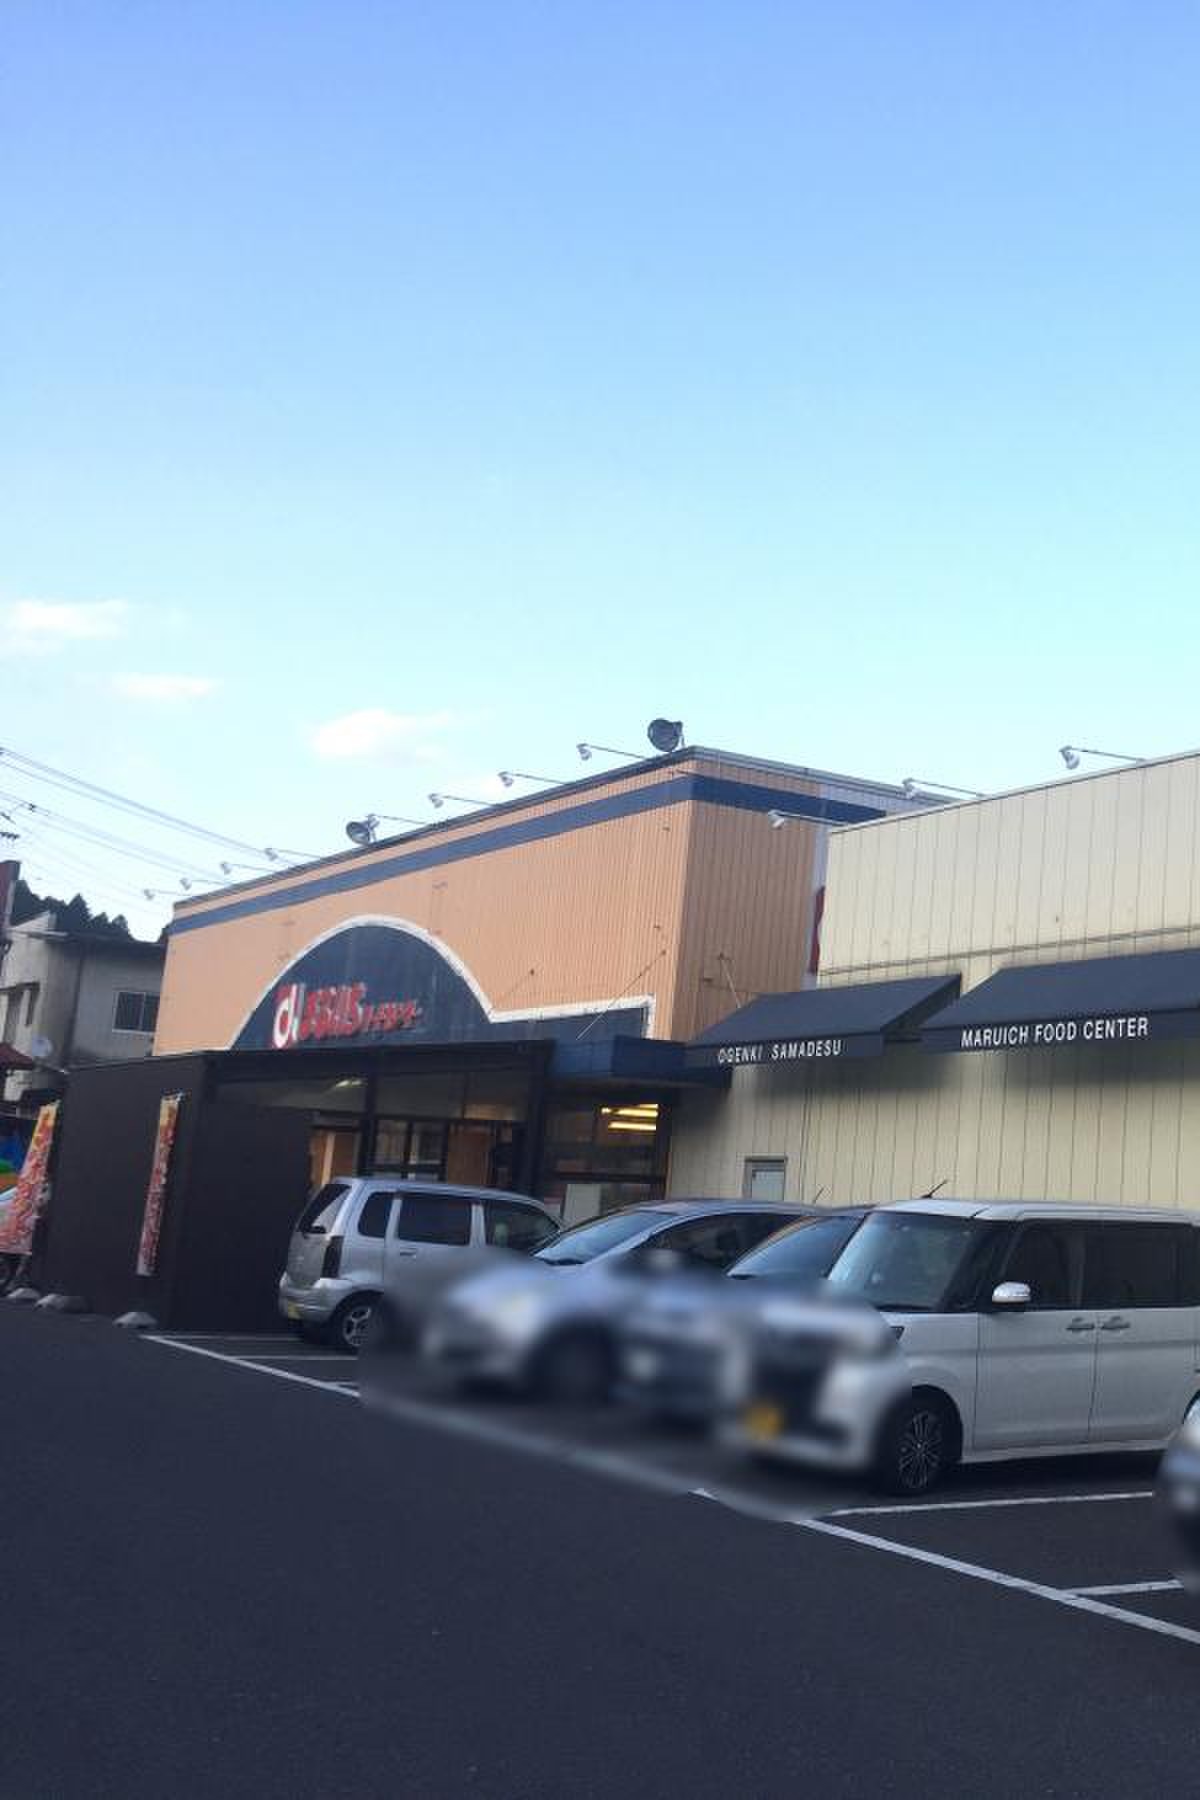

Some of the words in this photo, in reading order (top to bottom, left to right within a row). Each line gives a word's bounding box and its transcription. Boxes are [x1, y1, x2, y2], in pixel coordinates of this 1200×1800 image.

[960, 1025, 1029, 1048] MARUICH
[1033, 1021, 1077, 1044] FOOD
[1082, 1016, 1149, 1040] CENTER
[717, 1045, 763, 1064] OGENKI
[770, 1039, 843, 1061] SAMADESU
